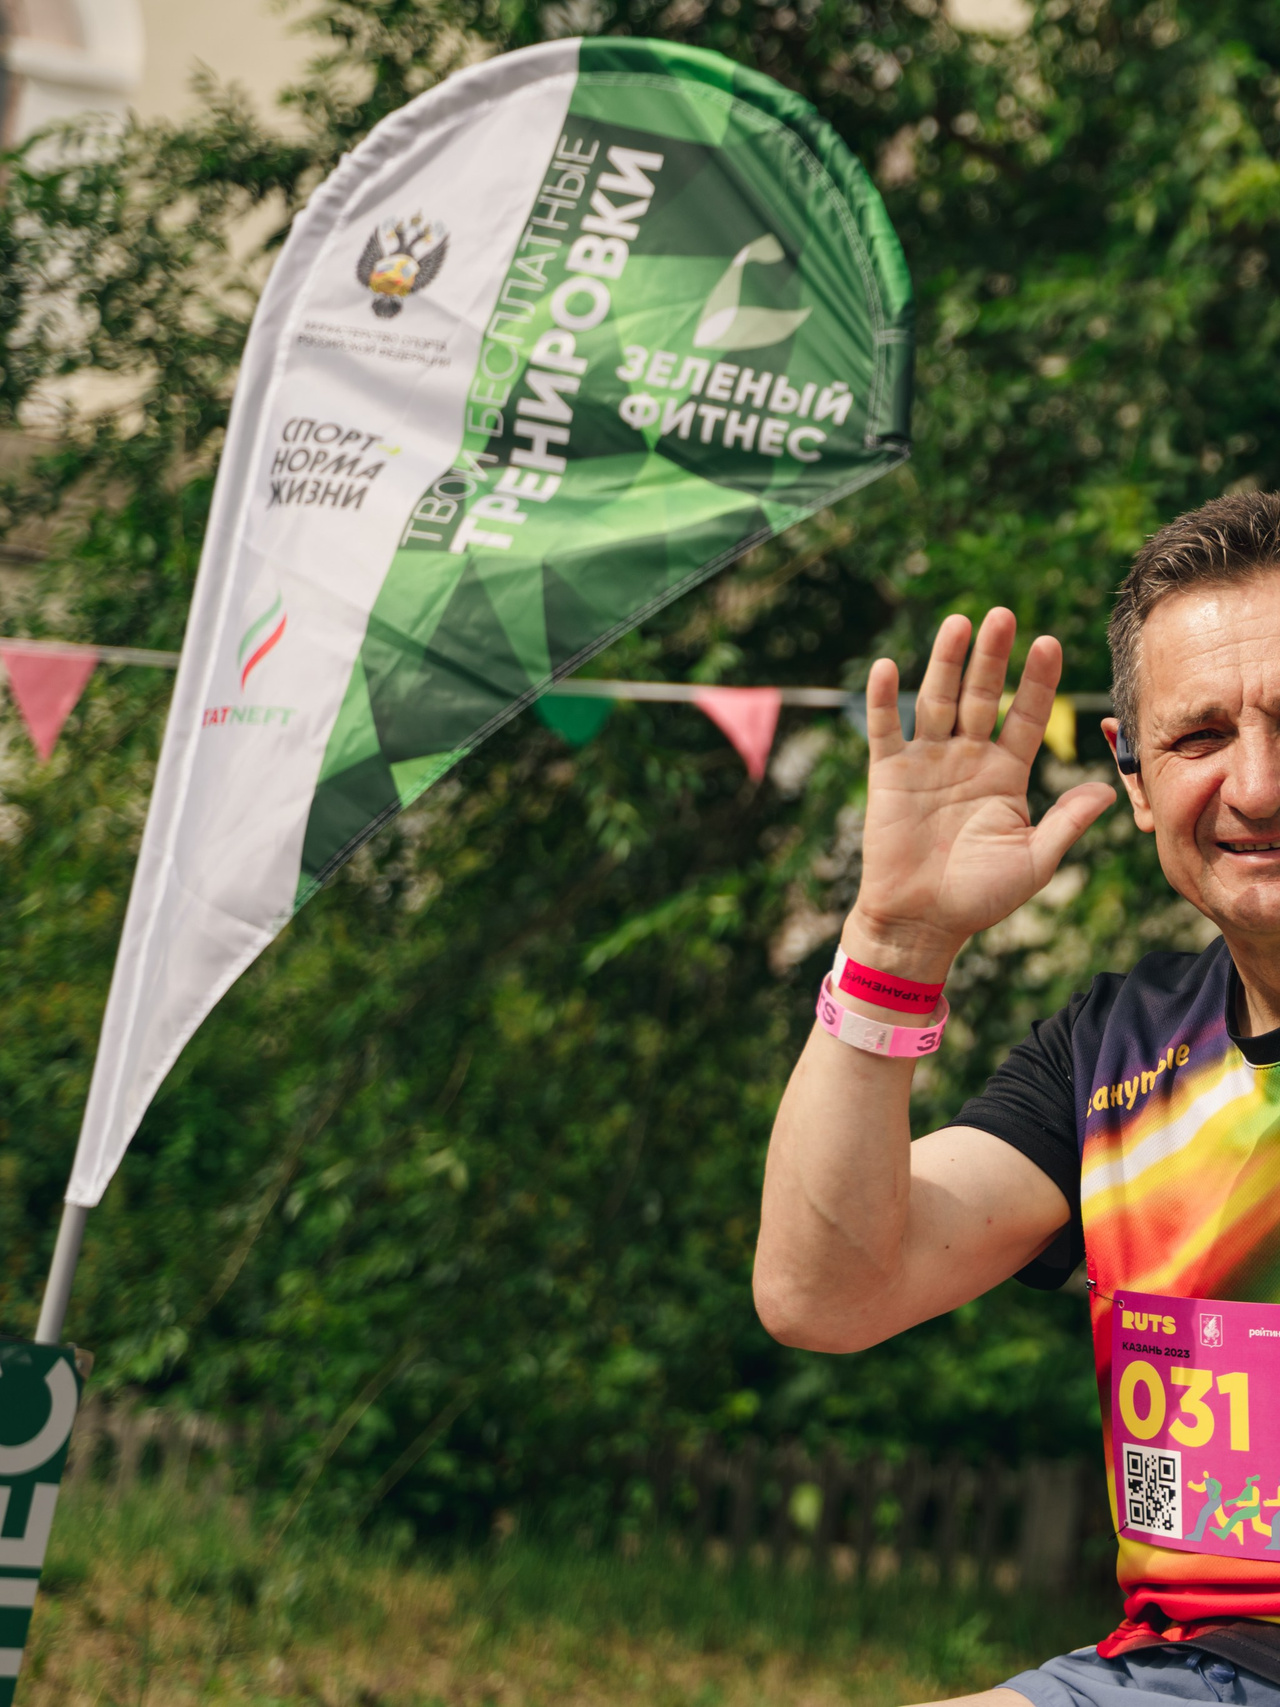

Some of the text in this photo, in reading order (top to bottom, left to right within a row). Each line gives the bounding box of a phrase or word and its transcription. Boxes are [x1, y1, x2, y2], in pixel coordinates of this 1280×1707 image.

[401, 134, 600, 547] ТВОИ БЕСПЛАТНЫЕ
[449, 145, 665, 555] ТРЕНИРОВКИ
[615, 345, 854, 426] ЗЕЛЕНЫЙ
[282, 417, 384, 452] СПОРТ
[618, 392, 828, 463] ФИТНЕС
[270, 448, 386, 480] НОРМА
[266, 479, 369, 510] ЖИЗНИ
[845, 970, 921, 1002] ХРАНЕНИЯ
[1122, 1310, 1177, 1335] RUTS
[1122, 1341, 1191, 1358] КАЗАНЬ 2023
[1119, 1360, 1250, 1452] 031
